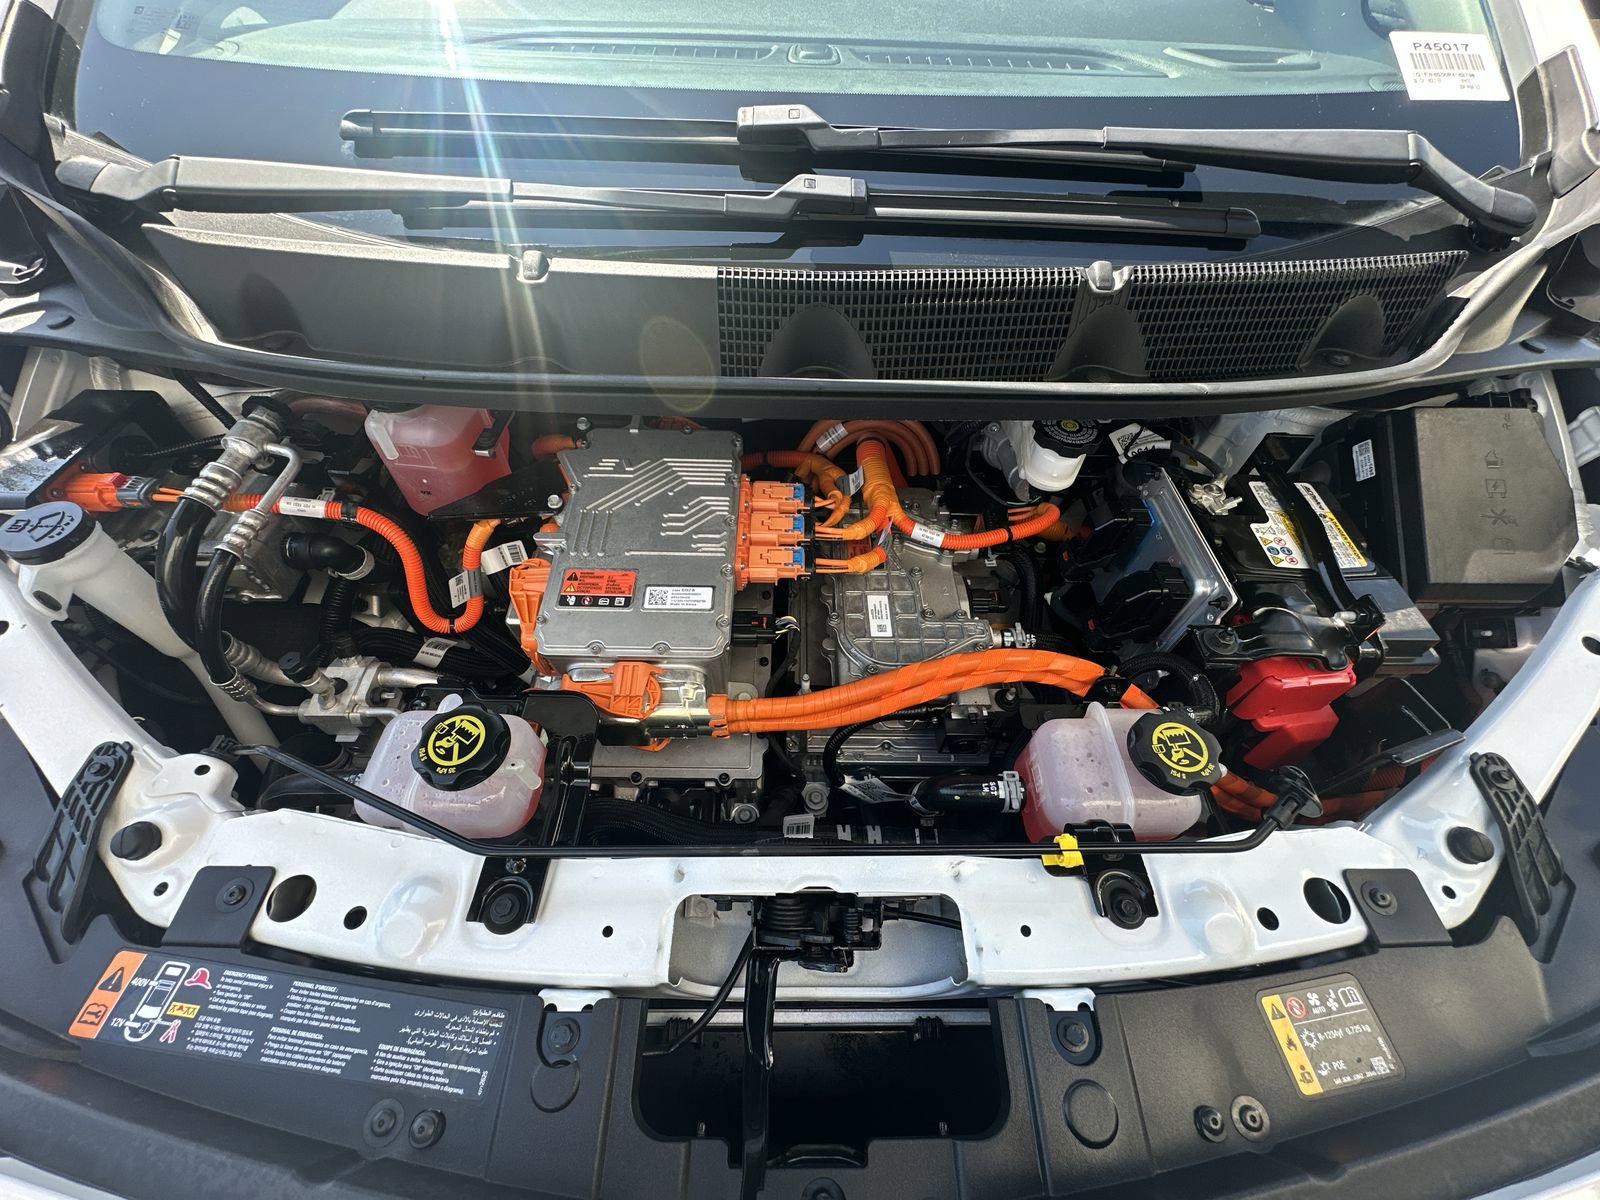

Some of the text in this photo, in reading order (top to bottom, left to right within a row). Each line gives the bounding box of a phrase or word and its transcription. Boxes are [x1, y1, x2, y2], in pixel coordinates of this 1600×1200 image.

[1413, 42, 1469, 52] P45017
[131, 976, 149, 987] 400V
[1313, 1006, 1326, 1015] AUTO
[111, 1017, 124, 1028] 12V
[1318, 1024, 1372, 1041] R-1234yf 0.725 kg
[1332, 1060, 1346, 1071] POE
